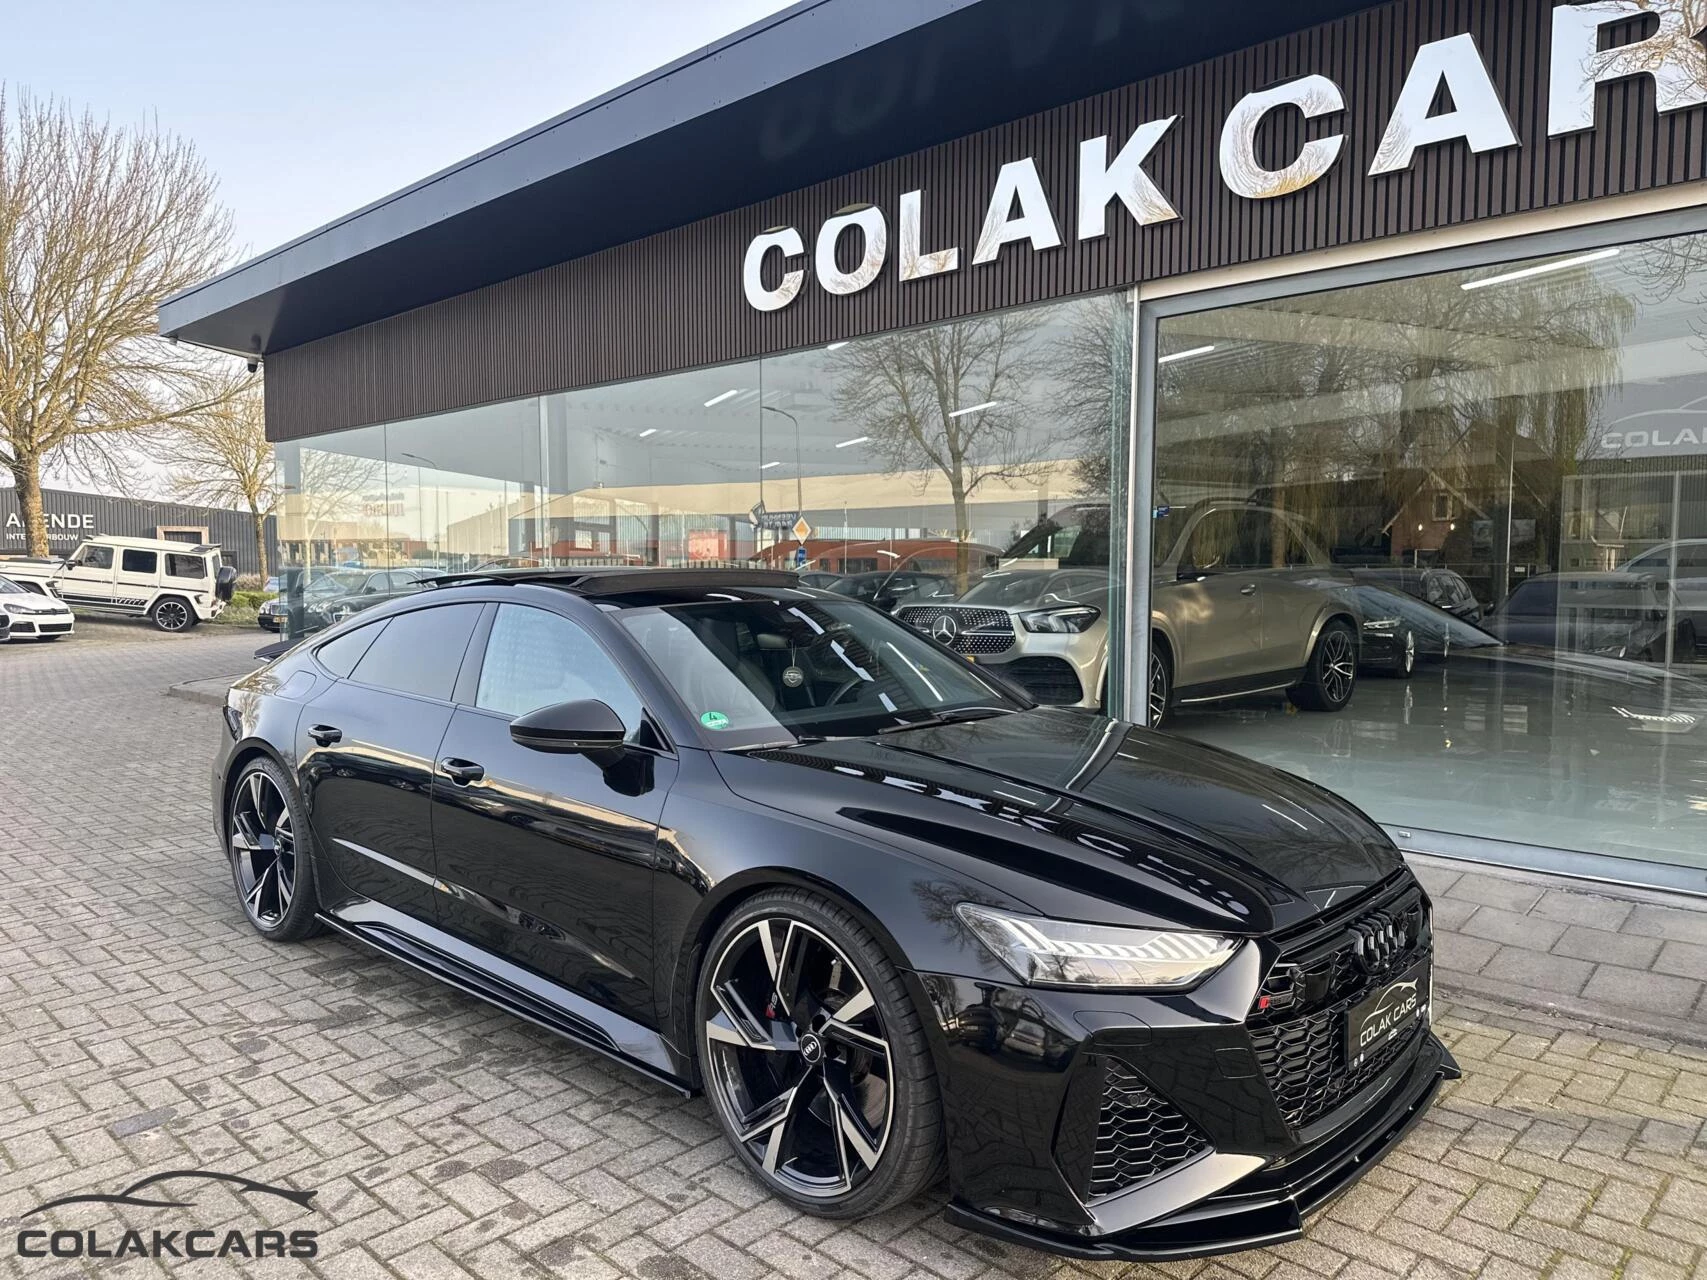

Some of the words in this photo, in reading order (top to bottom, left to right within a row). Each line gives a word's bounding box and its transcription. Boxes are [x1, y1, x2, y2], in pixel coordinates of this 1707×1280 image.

[743, 114, 1182, 313] COLAK
[1601, 427, 1707, 448] COLA
[1360, 1012, 1392, 1047] COLAK
[1393, 993, 1417, 1021] CARS
